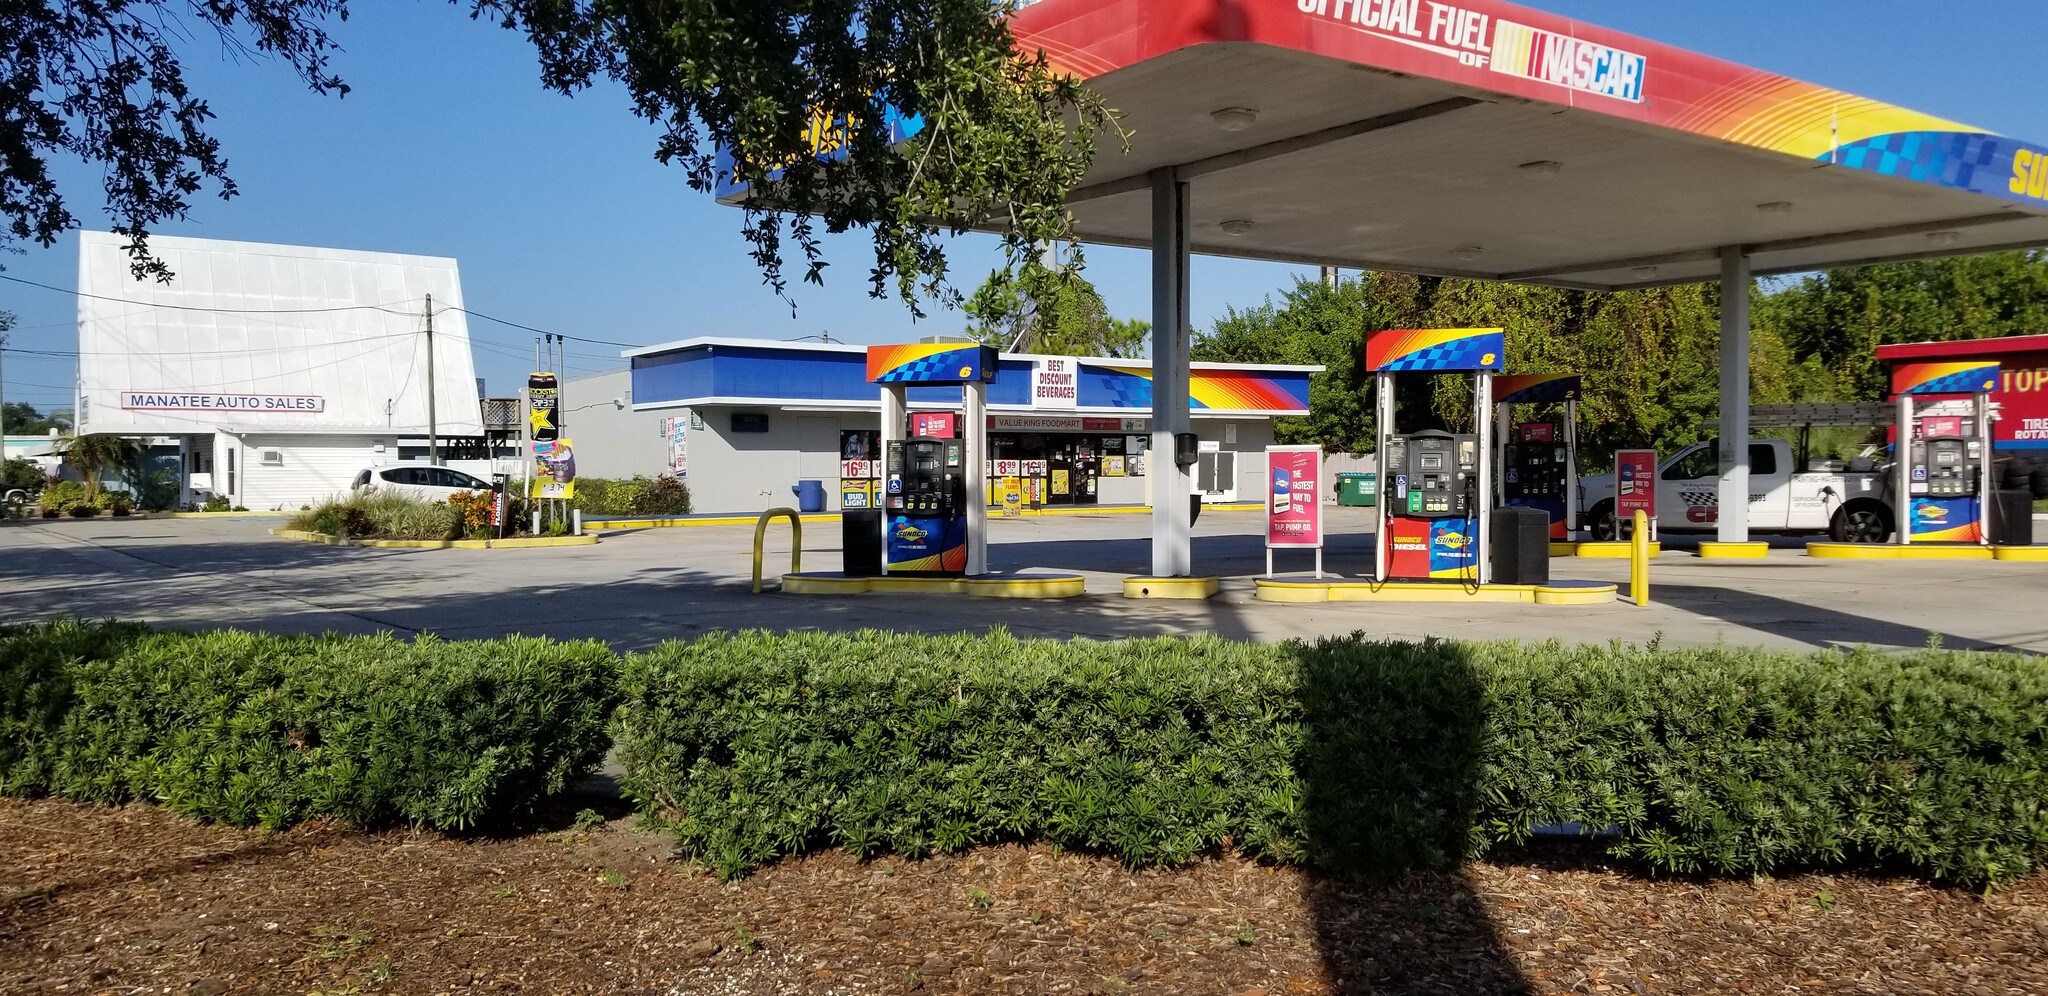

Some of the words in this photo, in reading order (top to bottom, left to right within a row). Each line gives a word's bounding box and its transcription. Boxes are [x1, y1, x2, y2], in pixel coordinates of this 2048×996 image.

[1426, 1, 1491, 53] FUEL
[1459, 51, 1489, 68] OF
[1540, 34, 1638, 100] NASCAR
[2009, 149, 2048, 200] SU
[1047, 360, 1064, 371] BEST
[1481, 353, 1495, 366] 8
[959, 366, 972, 378] 6
[1040, 373, 1072, 386] DISCOUNT
[1037, 386, 1075, 399] BEVERAGES
[131, 394, 211, 408] MANATEE
[215, 396, 260, 409] AUTO
[265, 398, 315, 410] SALES
[999, 418, 1023, 427] VALUE
[1024, 418, 1040, 427] KING
[1041, 419, 1080, 428] FOODMART
[1293, 470, 1302, 478] THE
[1293, 481, 1314, 490] FASTEST
[1293, 493, 1303, 503] WAY
[1304, 493, 1311, 503] TO
[494, 492, 502, 527] FLORIDA
